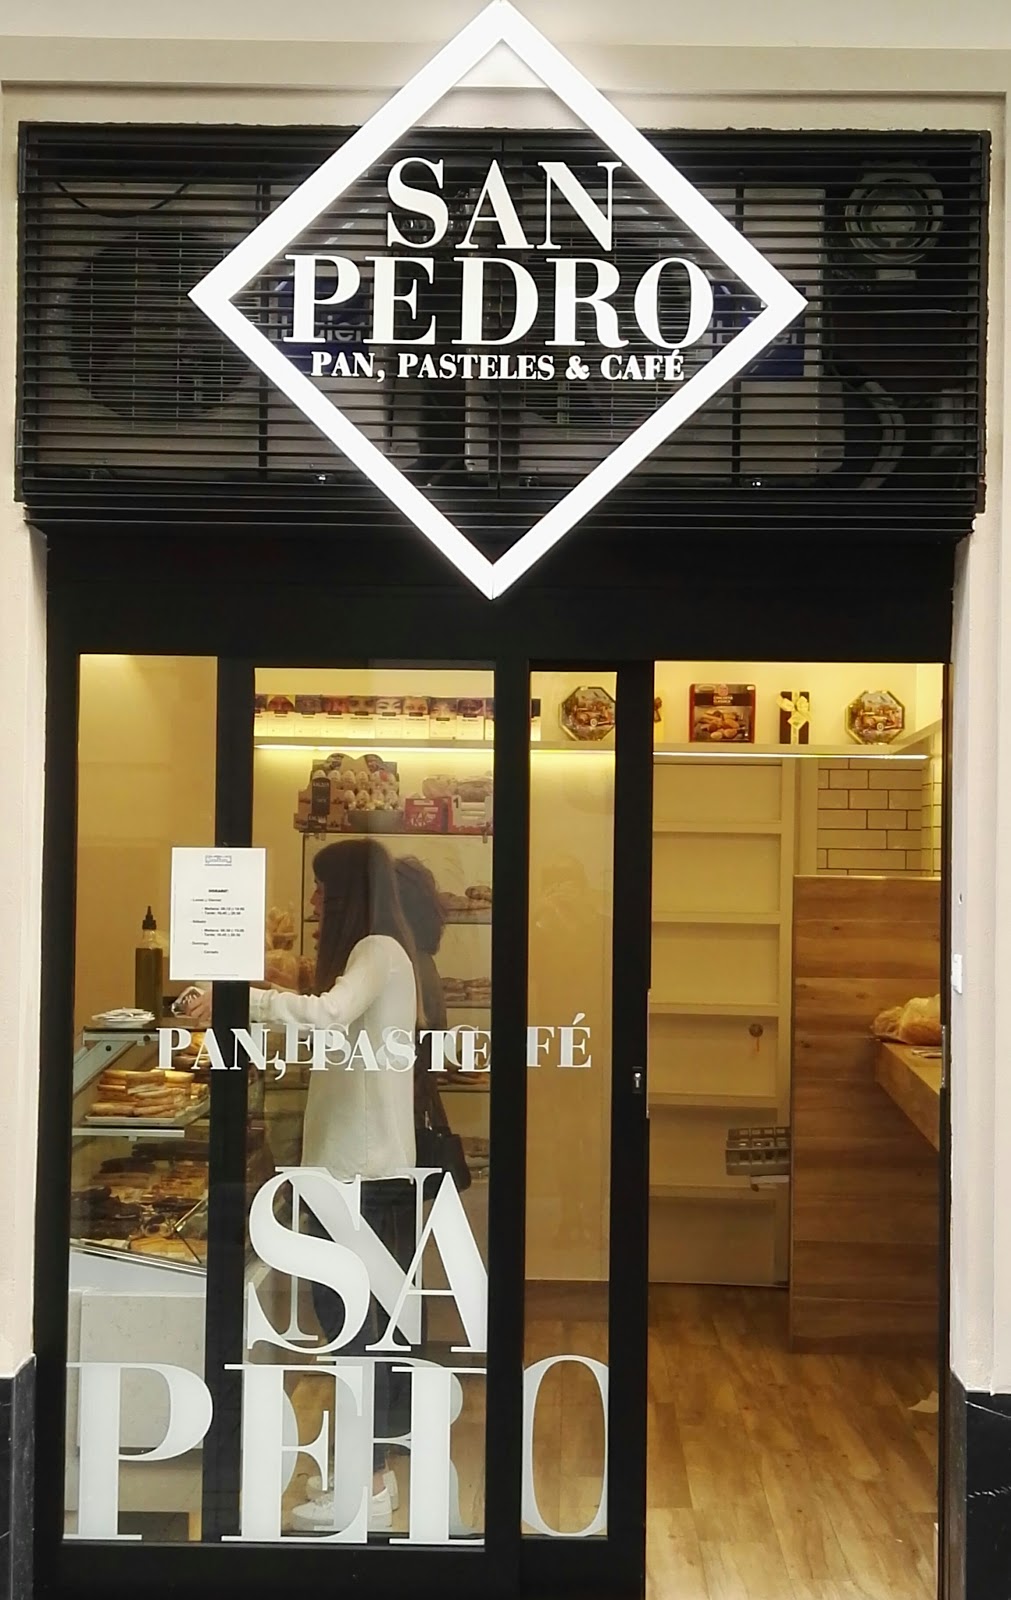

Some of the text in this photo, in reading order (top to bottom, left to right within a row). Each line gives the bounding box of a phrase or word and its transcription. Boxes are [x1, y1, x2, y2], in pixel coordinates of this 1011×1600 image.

[385, 156, 622, 252] SAN
[282, 253, 715, 349] PEDRO
[310, 348, 685, 384] PAN, PASTELES & CAFÉ
